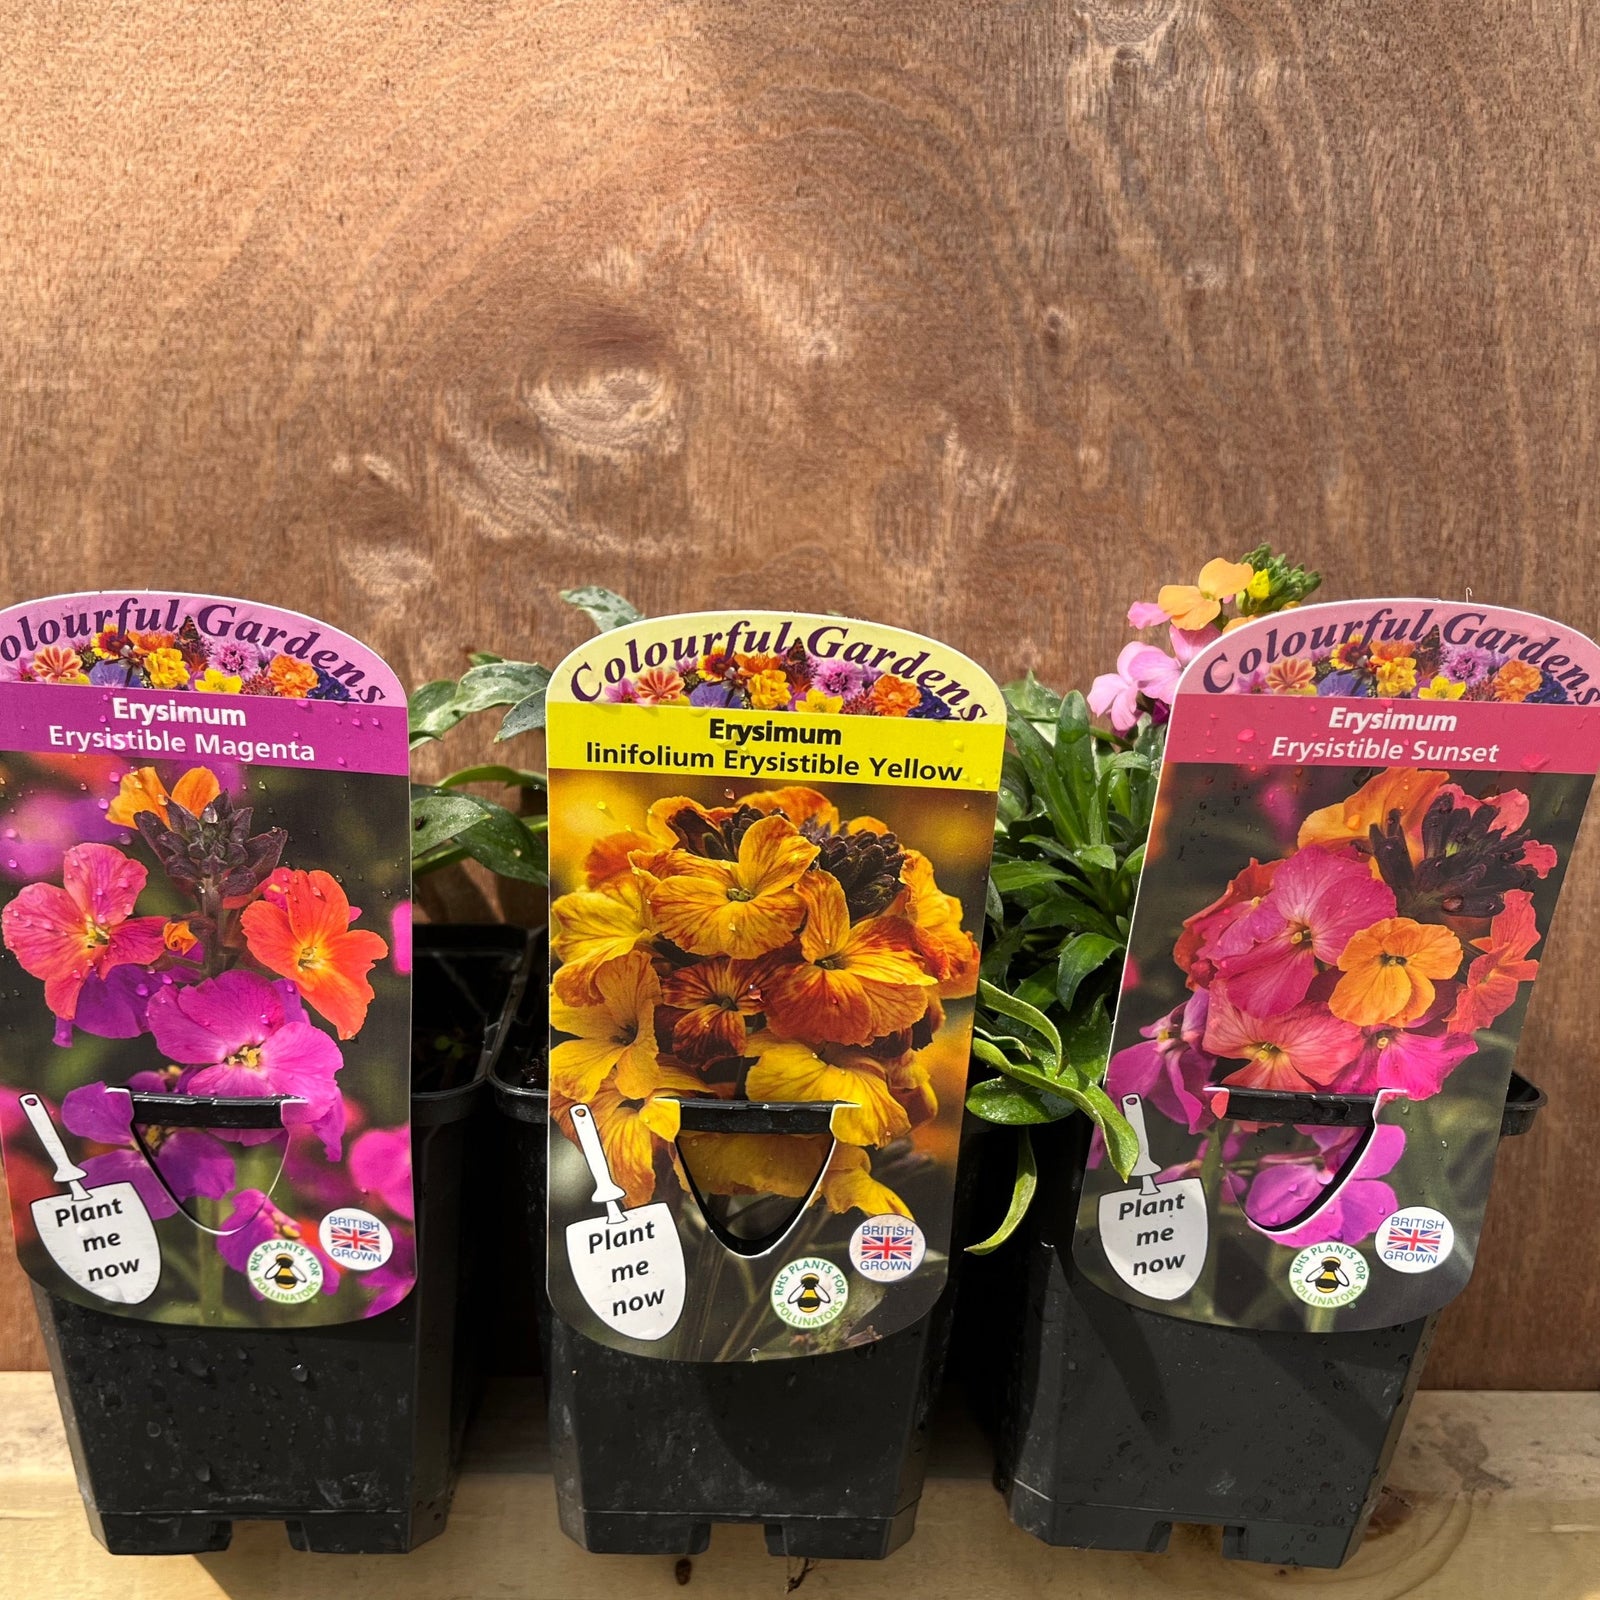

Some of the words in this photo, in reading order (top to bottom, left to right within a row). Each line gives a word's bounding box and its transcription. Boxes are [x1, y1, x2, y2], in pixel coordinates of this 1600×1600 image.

[0, 598, 182, 663] olourful
[197, 604, 387, 704] Gardens
[1202, 608, 1435, 694] Colourful
[1443, 612, 1600, 705] Gardens
[571, 620, 796, 702] Colourful
[807, 625, 989, 722] Gardens
[113, 697, 246, 727] Erysimum
[1328, 707, 1457, 734] Erysimum
[49, 725, 186, 755] Erysistible
[195, 733, 316, 762] Magenta
[709, 718, 842, 746] Erysimum
[586, 742, 715, 768] linifolium
[724, 750, 860, 776] Erysistible
[869, 757, 965, 781] Yellow
[1271, 736, 1404, 762] Erysistible
[1411, 740, 1500, 764] Sunset
[55, 1198, 123, 1228] Plant
[1119, 1193, 1186, 1221] Plant
[328, 1215, 381, 1232] BRITISH
[861, 1225, 915, 1237] BRITISH
[1136, 1224, 1174, 1246] me
[1390, 1216, 1445, 1230] BRITISH
[83, 1232, 122, 1253] me
[588, 1220, 655, 1254] Plant
[250, 1251, 264, 1272] RHS
[261, 1240, 306, 1257] PLANTS
[305, 1254, 320, 1277] FOR
[330, 1248, 383, 1263] GROWN
[859, 1260, 912, 1271] GROWN
[1133, 1252, 1186, 1275] now
[1293, 1253, 1310, 1274] RHS
[1310, 1242, 1356, 1262] PLANTS
[1354, 1260, 1366, 1281] FOR
[1383, 1250, 1438, 1264] GROWN
[88, 1258, 140, 1282] now
[611, 1260, 649, 1283] me
[774, 1272, 788, 1297] RHS
[787, 1261, 834, 1276] PLANTS
[832, 1273, 846, 1296] FOR
[253, 1276, 320, 1303] POLLINATORS
[612, 1289, 665, 1316] now
[1292, 1278, 1363, 1306] POLLINATORS
[776, 1300, 844, 1327] POLLINATORS
